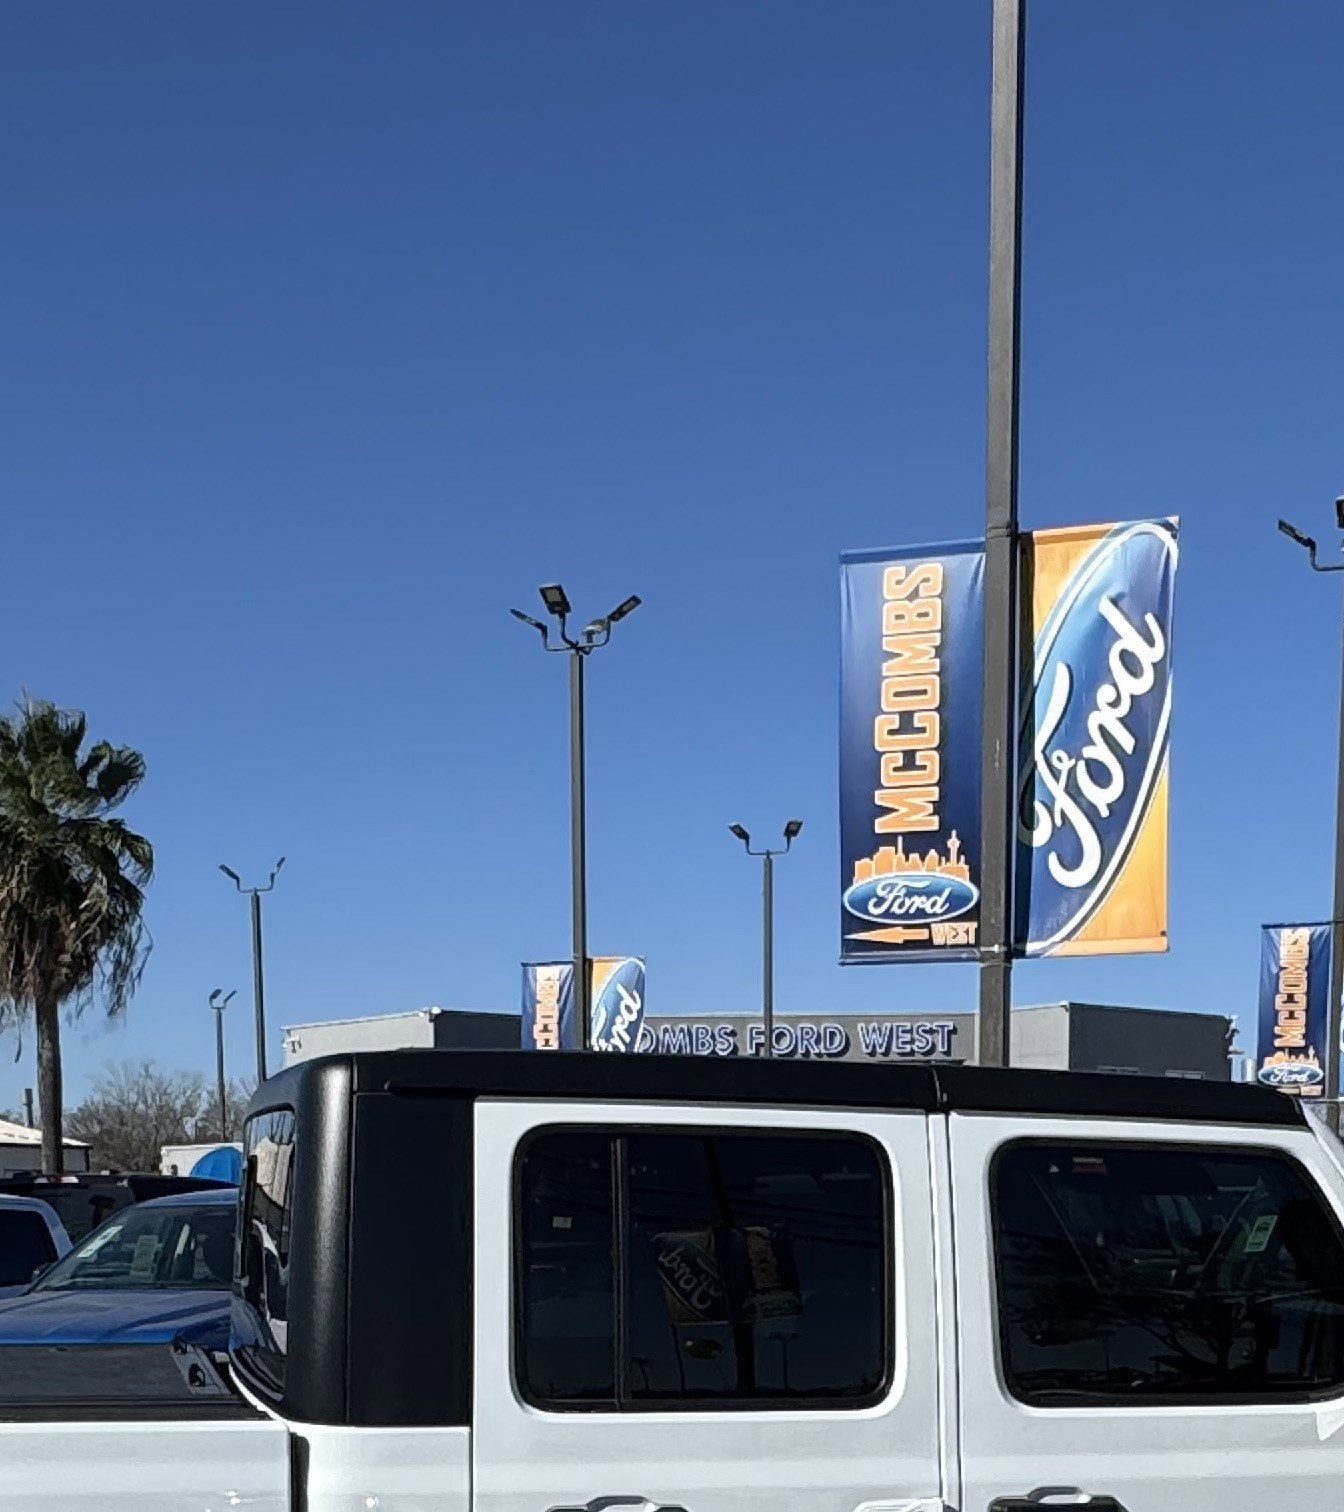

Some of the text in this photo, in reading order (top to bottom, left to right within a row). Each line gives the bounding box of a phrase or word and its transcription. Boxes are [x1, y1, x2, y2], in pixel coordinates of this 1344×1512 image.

[874, 562, 944, 834] MCCOMBS
[1018, 592, 1166, 888] Ford
[866, 879, 951, 915] Ford
[639, 1020, 955, 1057] OMBS FORD WEST
